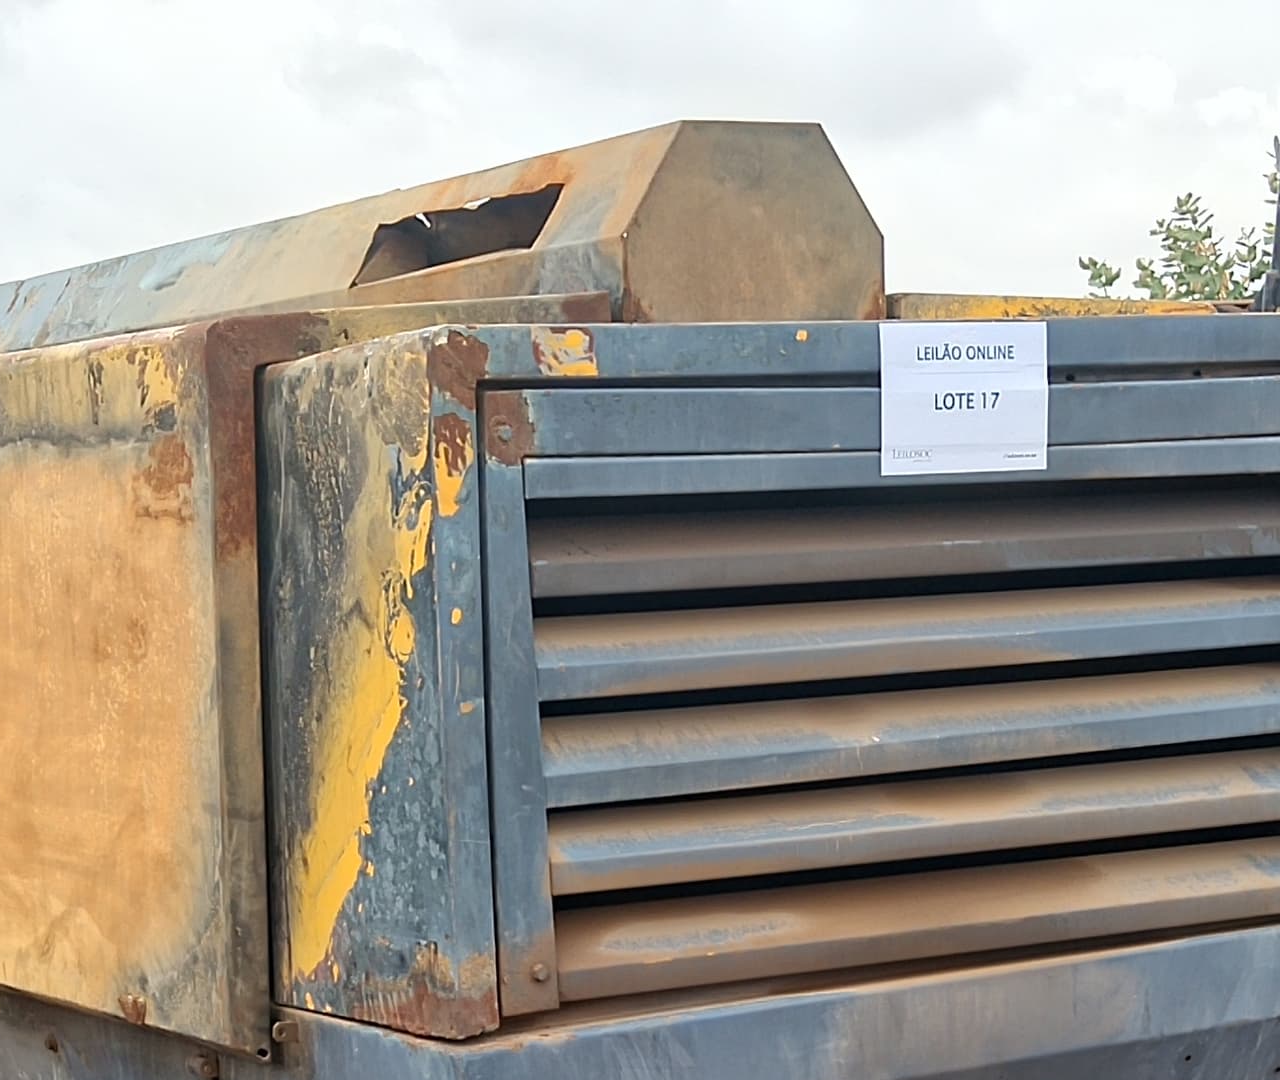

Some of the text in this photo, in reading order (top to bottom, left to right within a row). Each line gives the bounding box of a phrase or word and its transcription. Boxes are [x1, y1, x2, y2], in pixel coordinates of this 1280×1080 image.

[916, 343, 1015, 361] LEILÃO ONLINE
[934, 391, 1001, 411] LOTE 17
